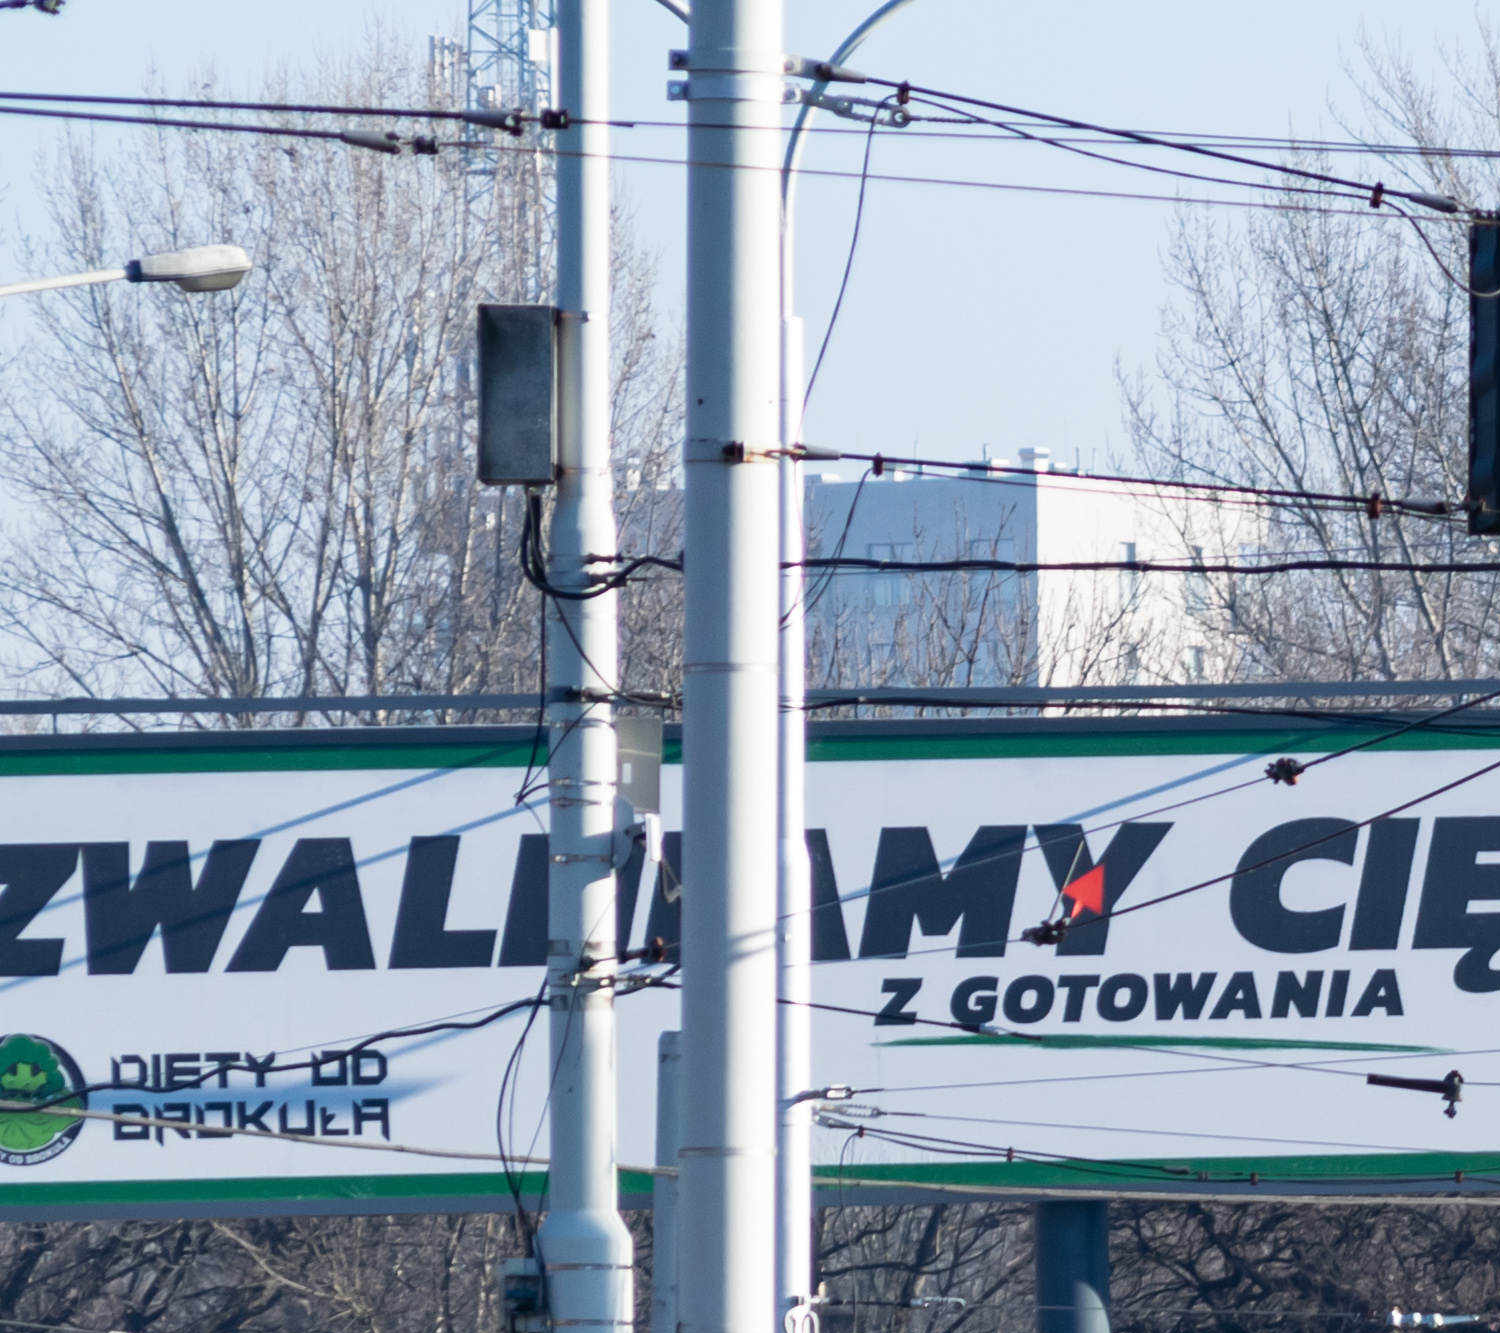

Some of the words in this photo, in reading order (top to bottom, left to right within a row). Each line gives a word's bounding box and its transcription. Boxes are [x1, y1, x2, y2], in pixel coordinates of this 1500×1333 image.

[874, 977, 924, 1027] Z
[949, 968, 1406, 1024] GOTOWANIA
[110, 1051, 276, 1090] DIETY
[310, 1049, 388, 1087] OD
[111, 1098, 391, 1147] BROKUŁA
